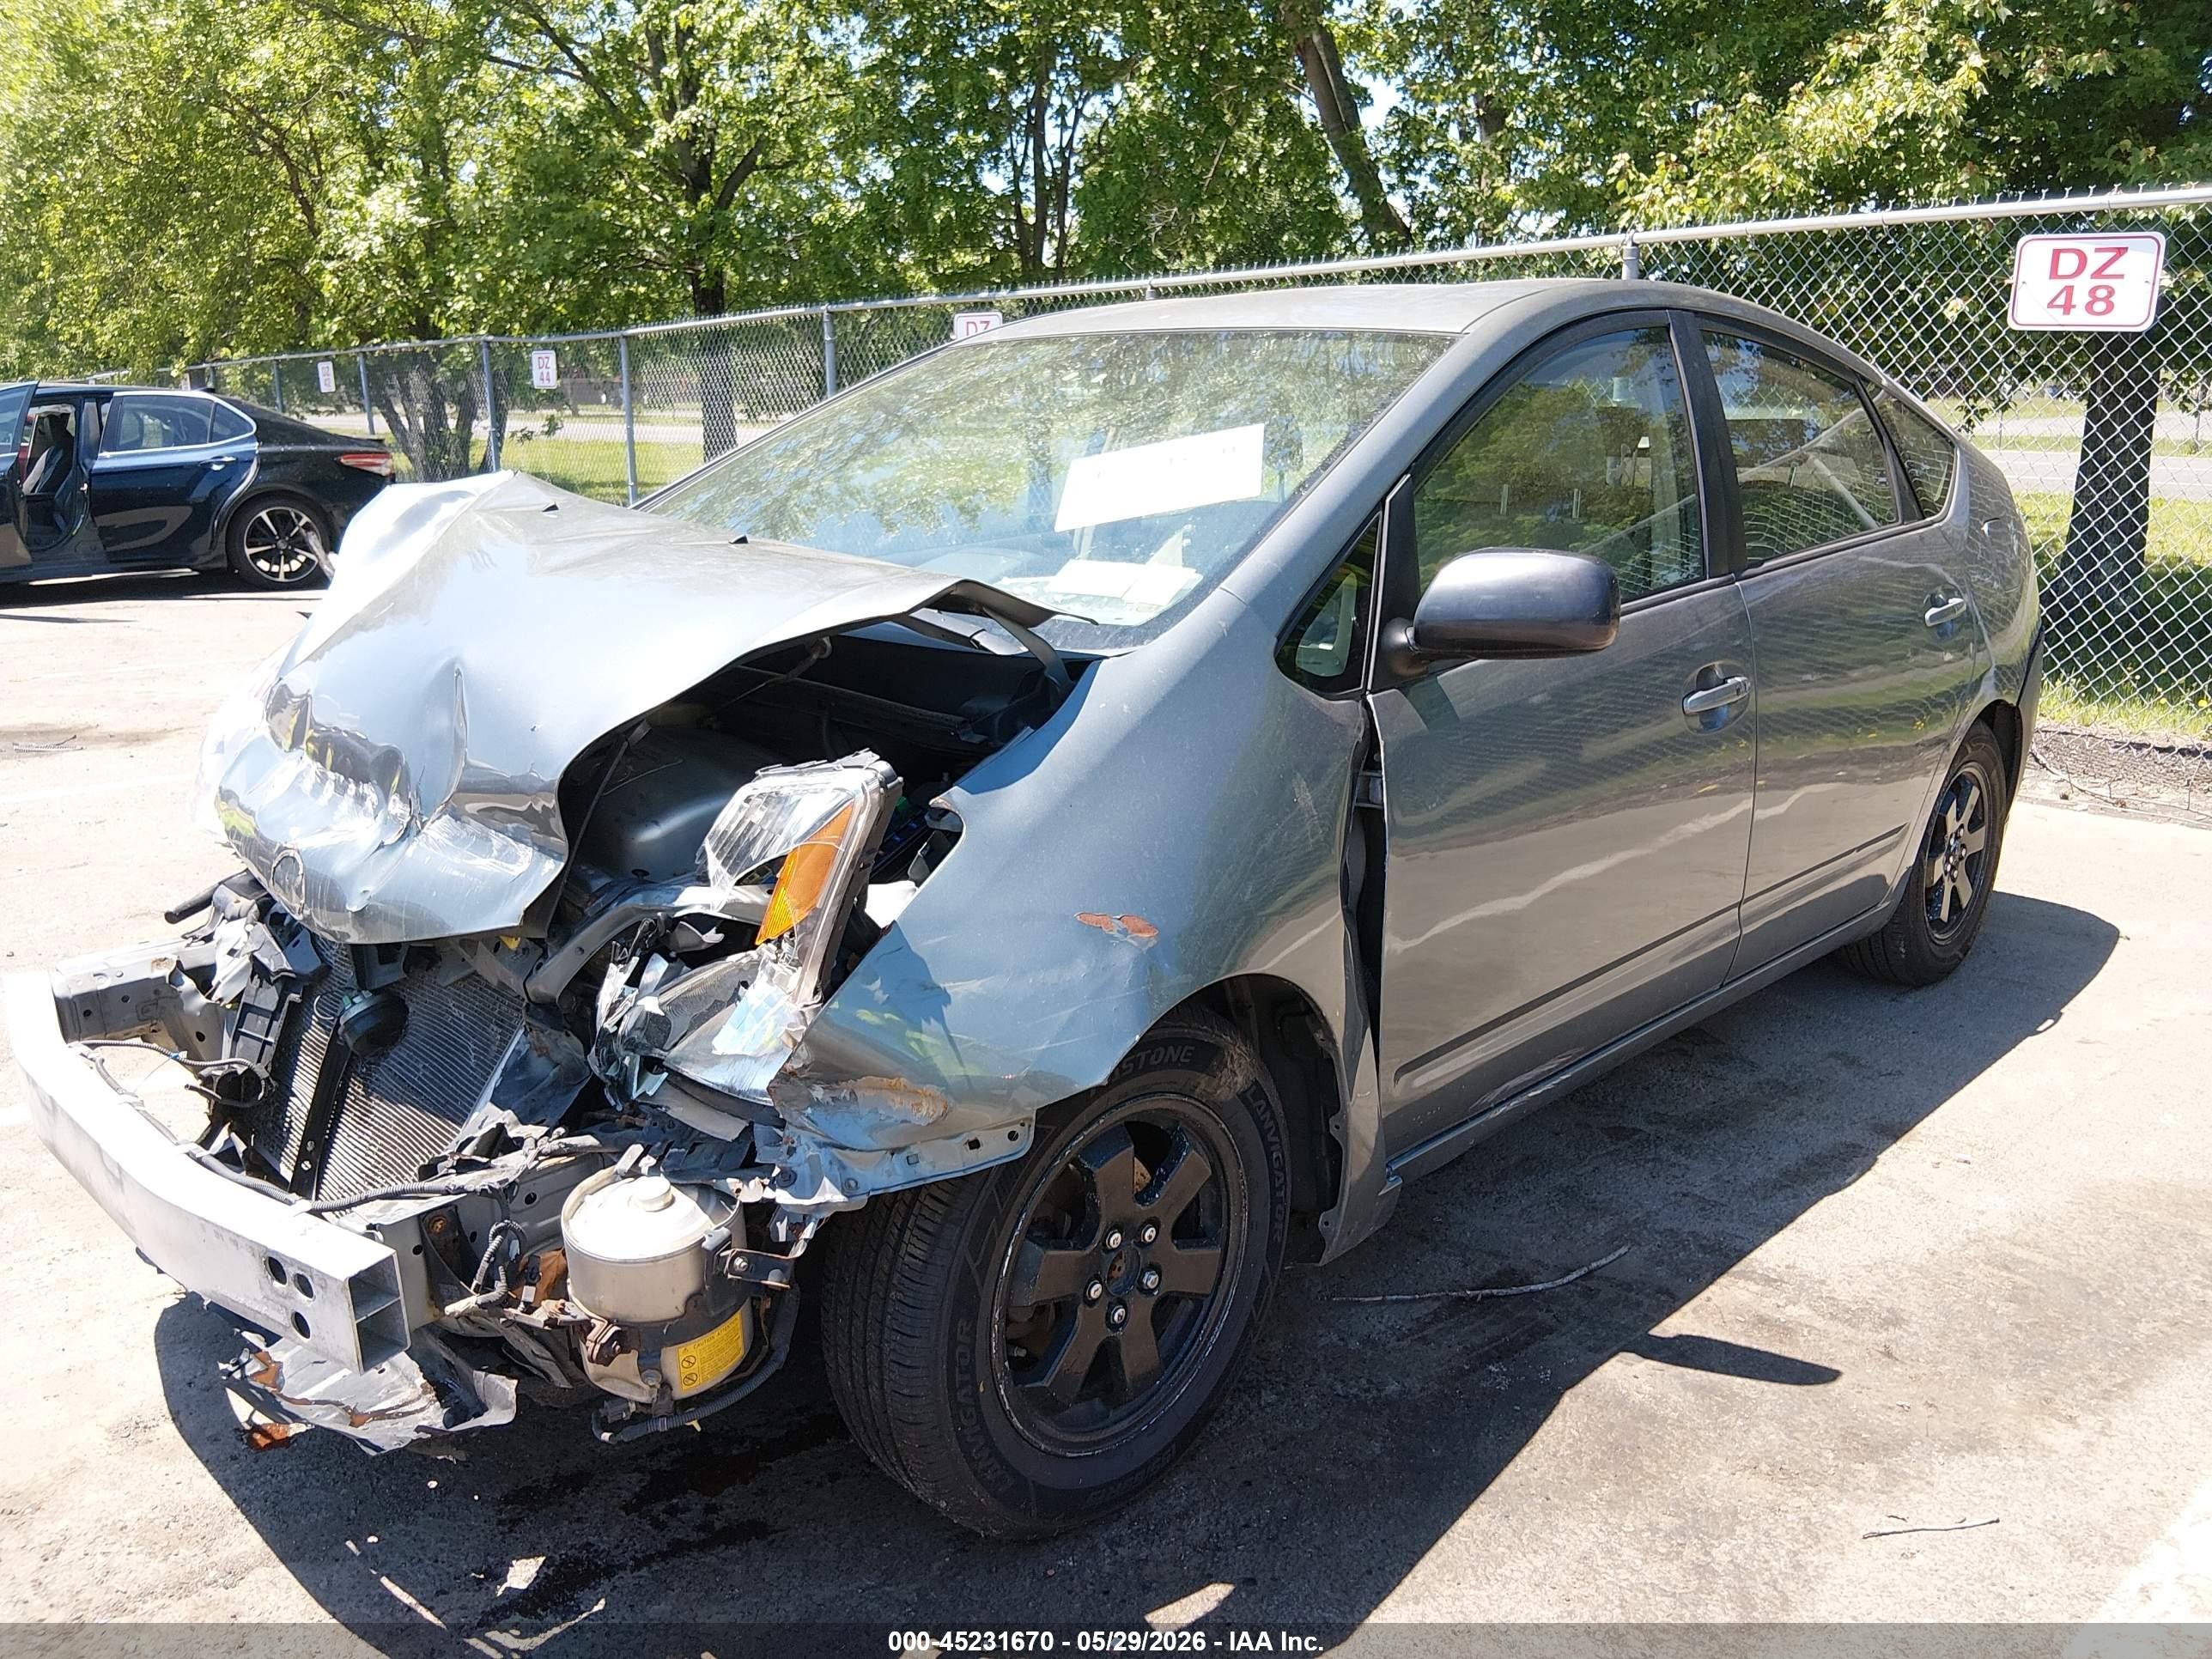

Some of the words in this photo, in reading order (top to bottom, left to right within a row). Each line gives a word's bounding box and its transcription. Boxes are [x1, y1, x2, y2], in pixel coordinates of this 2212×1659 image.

[2049, 246, 2129, 280] DZ
[2046, 285, 2115, 316] 48
[538, 356, 550, 369] DZ
[539, 370, 550, 384] 44
[1114, 1044, 1196, 1081] STONE
